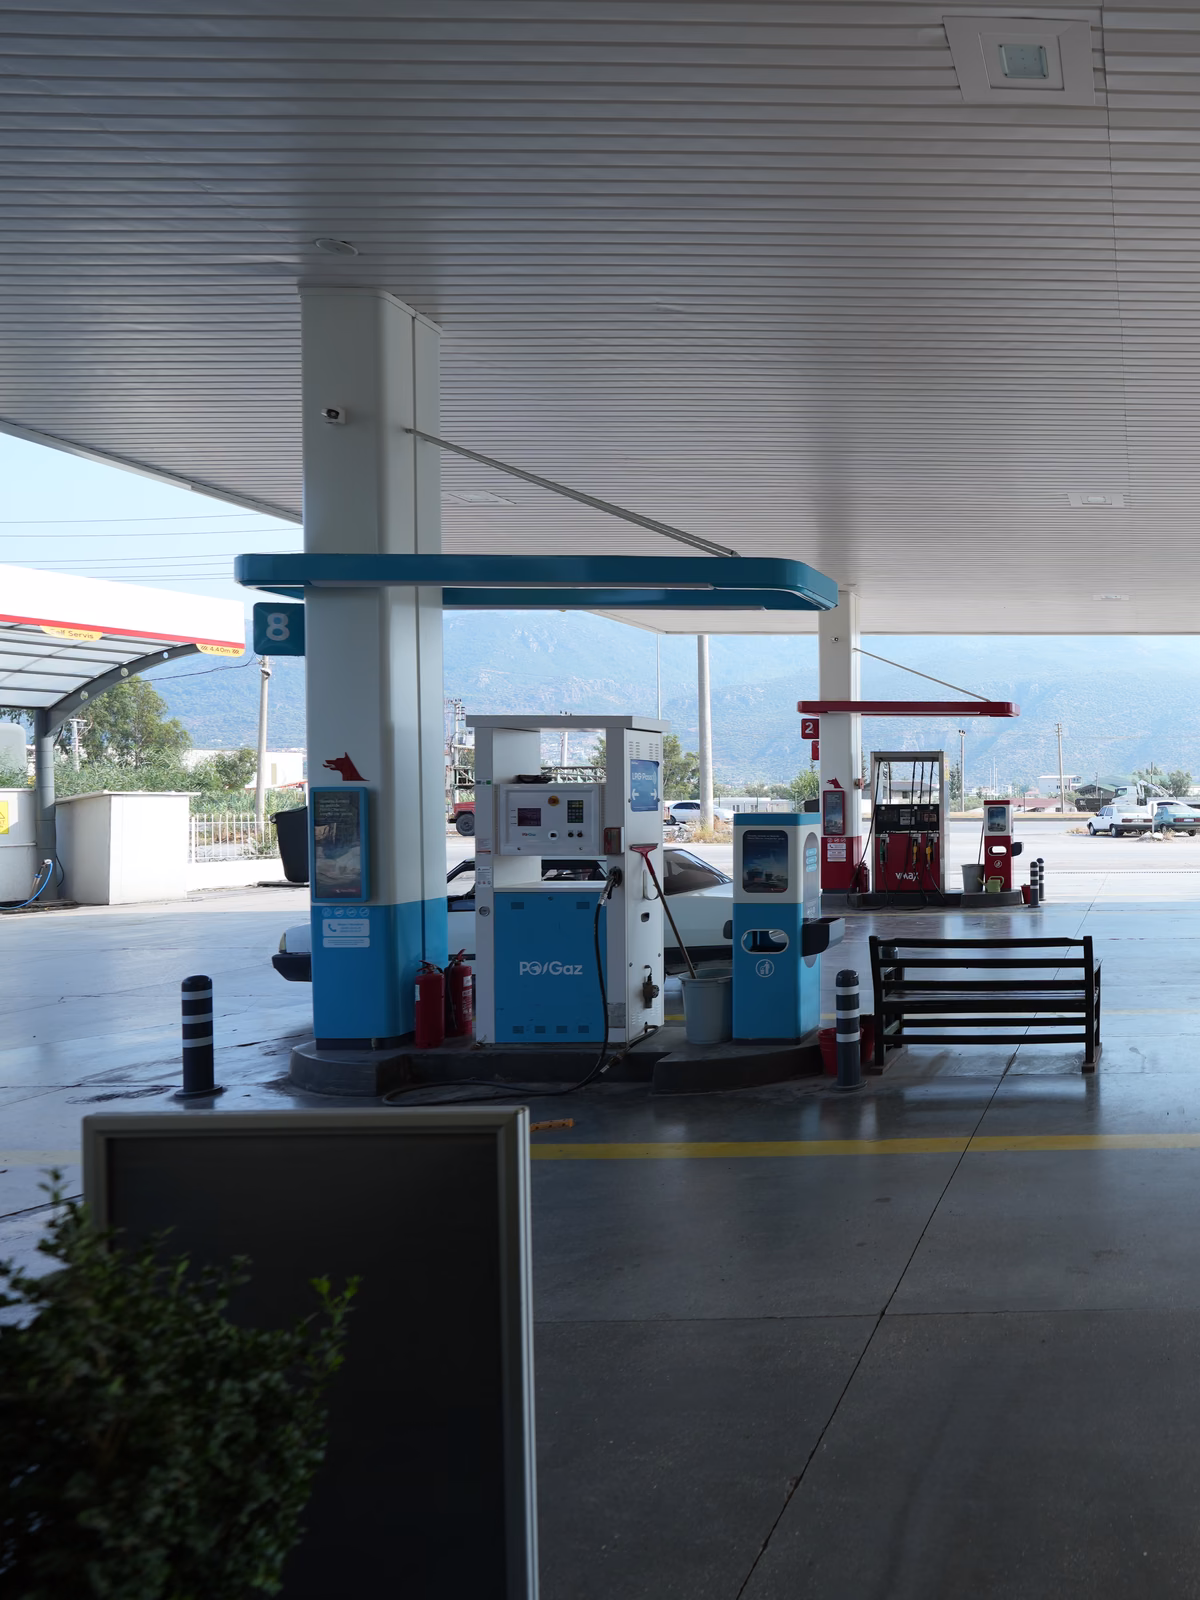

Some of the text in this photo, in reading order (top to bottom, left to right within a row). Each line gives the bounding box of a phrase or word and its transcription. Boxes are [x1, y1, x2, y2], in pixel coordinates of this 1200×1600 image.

[266, 612, 290, 642] 8
[68, 630, 94, 639] Servis
[804, 721, 814, 734] 2
